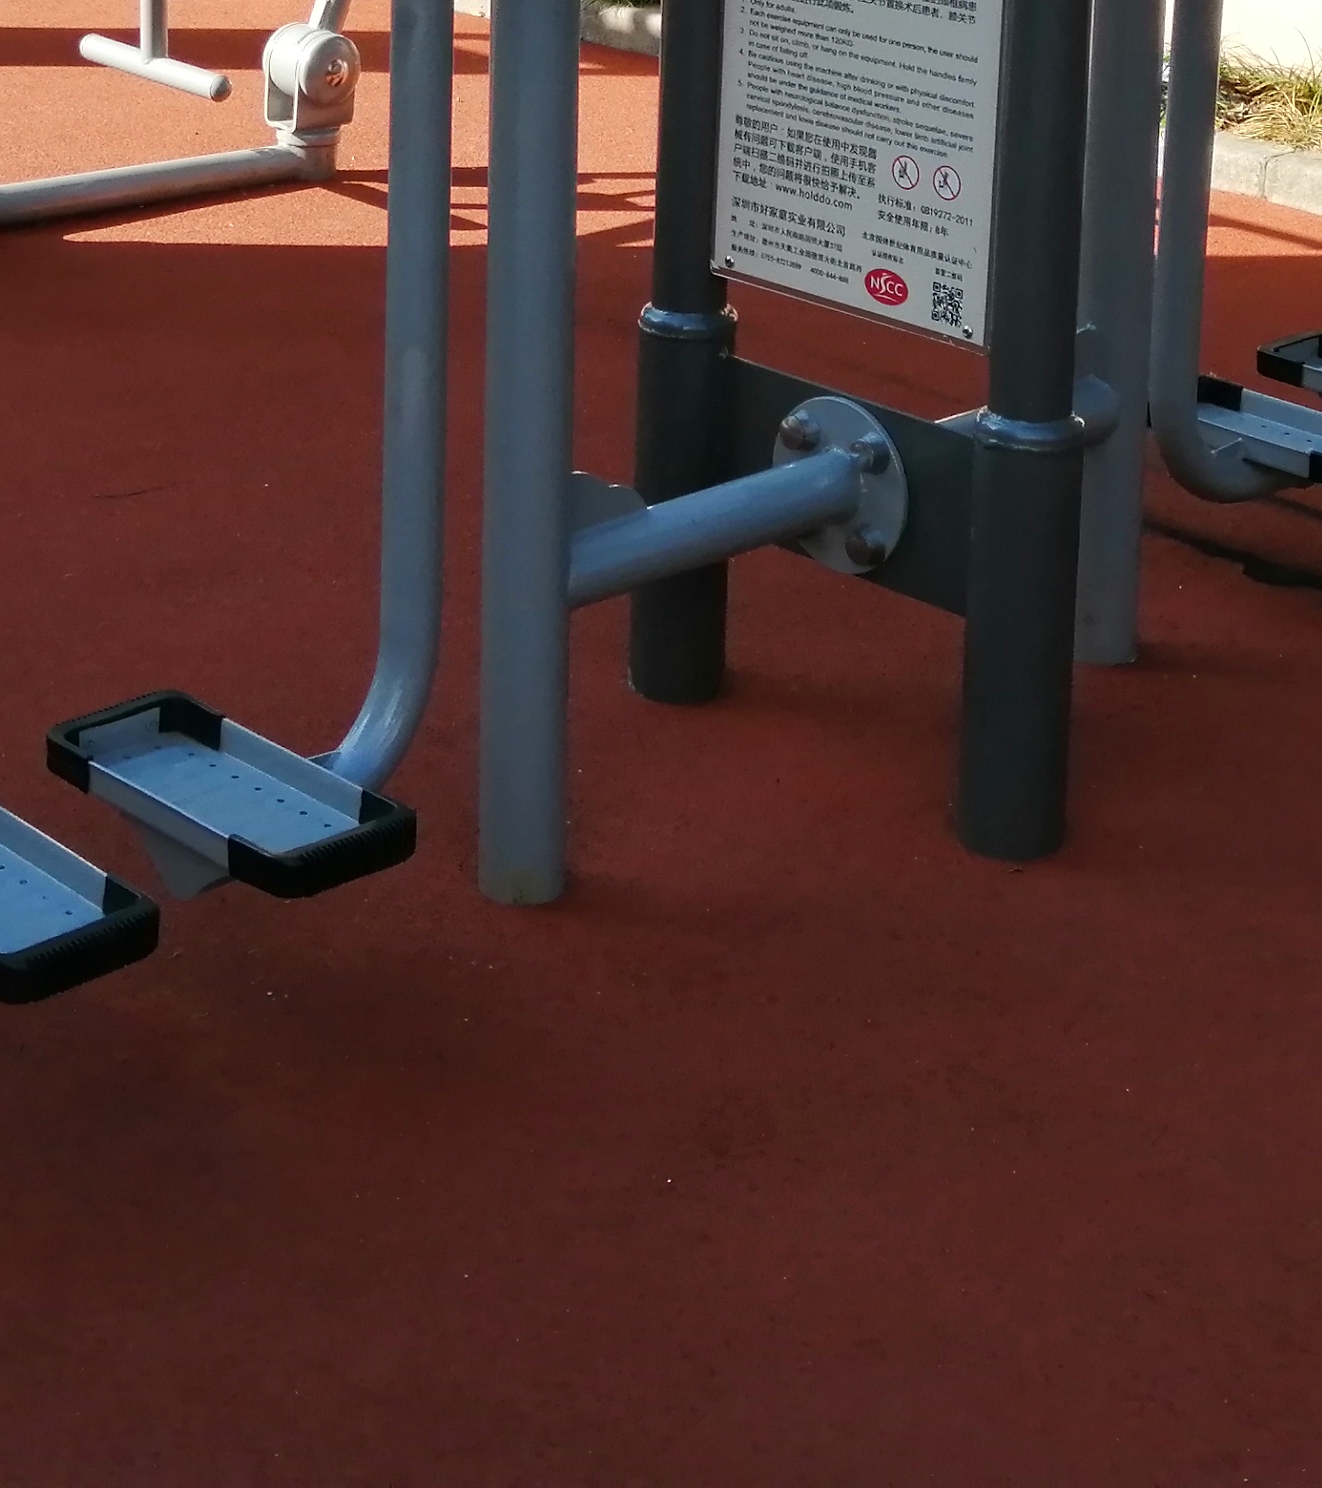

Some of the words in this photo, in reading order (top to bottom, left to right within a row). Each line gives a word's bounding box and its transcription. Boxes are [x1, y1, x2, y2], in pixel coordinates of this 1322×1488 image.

[760, 31, 770, 40] not
[838, 49, 847, 57] on
[848, 51, 859, 60] the
[899, 61, 916, 72] Hold
[916, 65, 928, 75] the
[958, 75, 978, 87] firmly
[852, 30, 861, 38] be
[862, 32, 878, 43] used
[879, 34, 888, 44] for
[888, 38, 901, 47] one
[902, 41, 926, 54] person,
[927, 46, 939, 55] the
[939, 50, 954, 59] user
[955, 53, 979, 64] should
[785, 58, 803, 70] using
[803, 62, 814, 71] the
[859, 75, 886, 89] drinking
[895, 84, 909, 93] with
[910, 87, 938, 100] physical
[734, 128, 877, 174] 械有问题可下载客户端，使用手机客
[731, 196, 846, 238] 深圳市好家庭实业有限公司
[870, 272, 904, 297] NSCC
